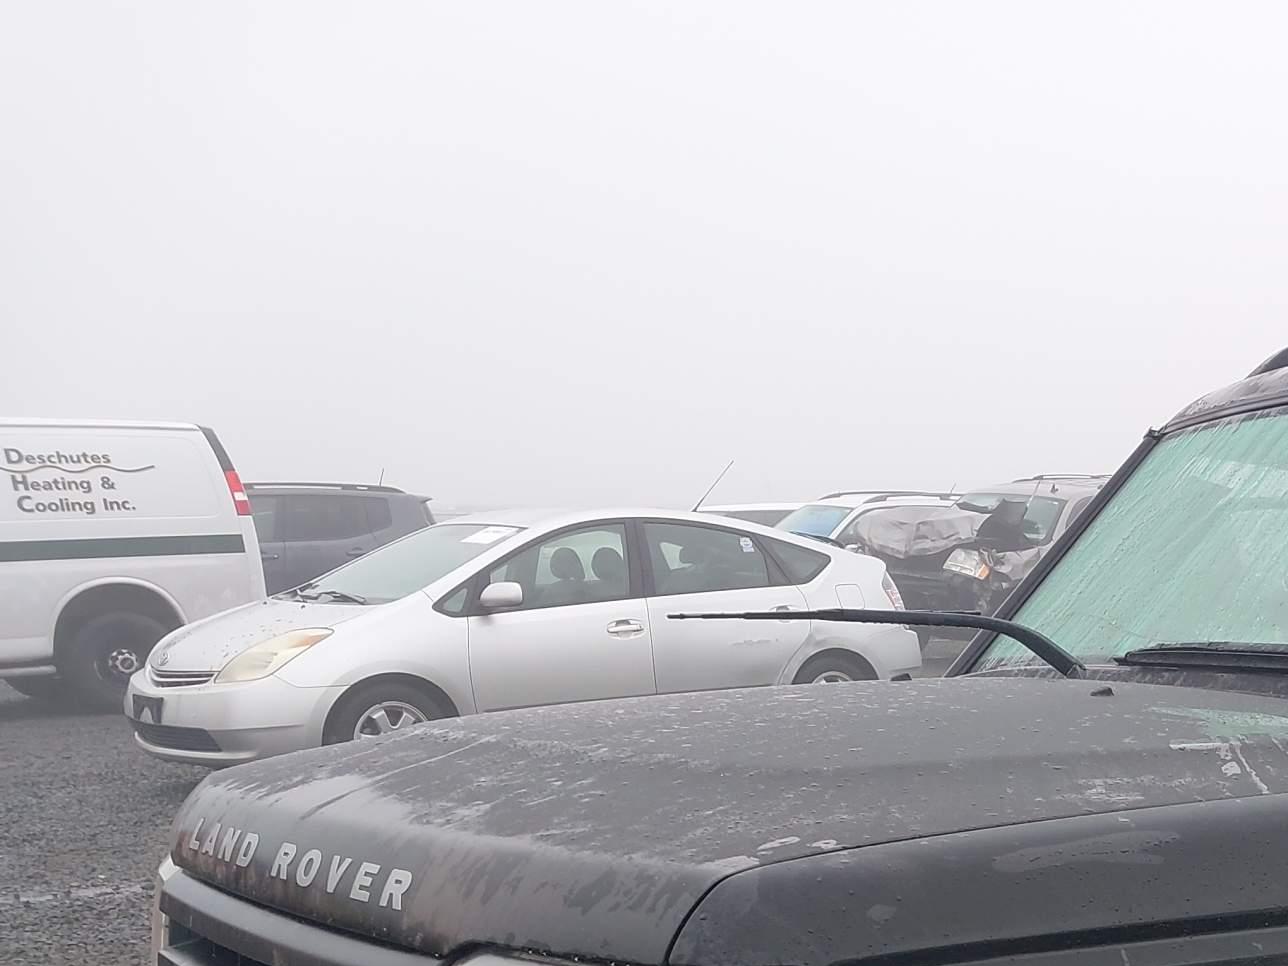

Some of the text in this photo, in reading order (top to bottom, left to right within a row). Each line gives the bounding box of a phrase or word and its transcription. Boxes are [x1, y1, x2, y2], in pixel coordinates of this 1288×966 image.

[4, 448, 111, 464] Deschutes
[10, 474, 116, 493] Heating &
[16, 495, 136, 515] Cooling Inc.
[189, 818, 413, 911] LAND ROVER
